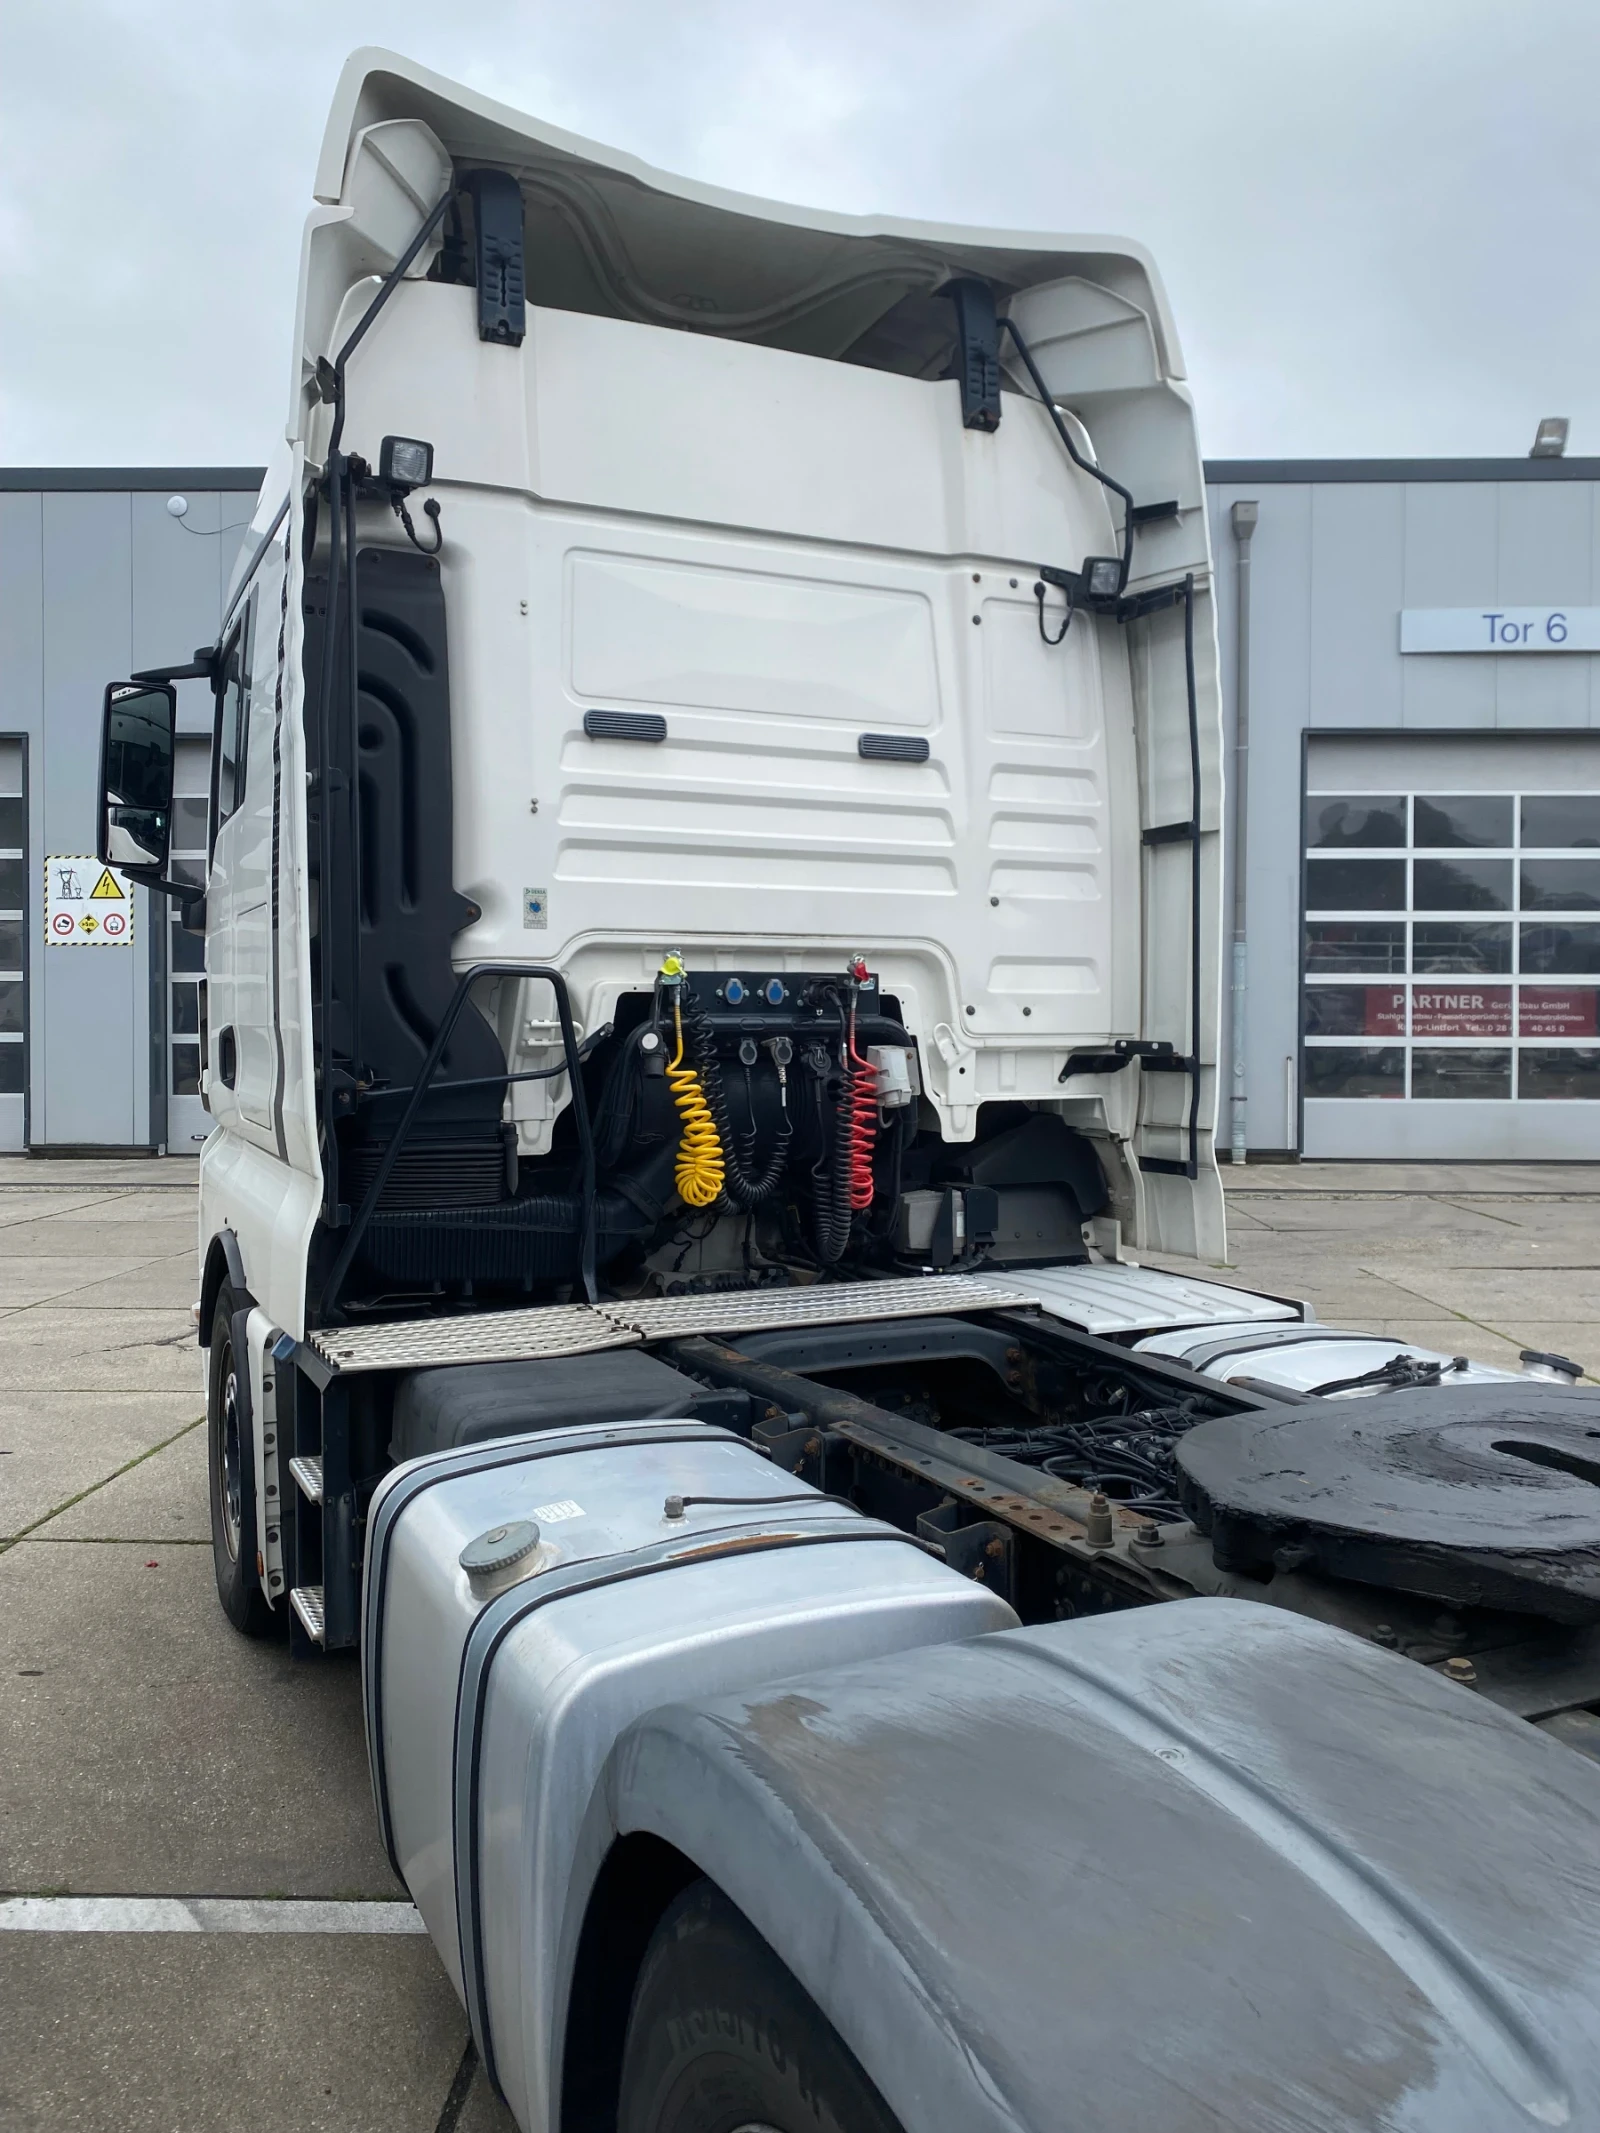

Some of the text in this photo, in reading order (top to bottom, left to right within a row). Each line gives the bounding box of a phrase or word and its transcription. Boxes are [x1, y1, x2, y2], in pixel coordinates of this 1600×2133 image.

[1482, 612, 1568, 643] Tor 6
[1393, 994, 1570, 1010] PARTNER Gerütbau GmbH
[1397, 1023, 1459, 1032] Kmp-Lintfort
